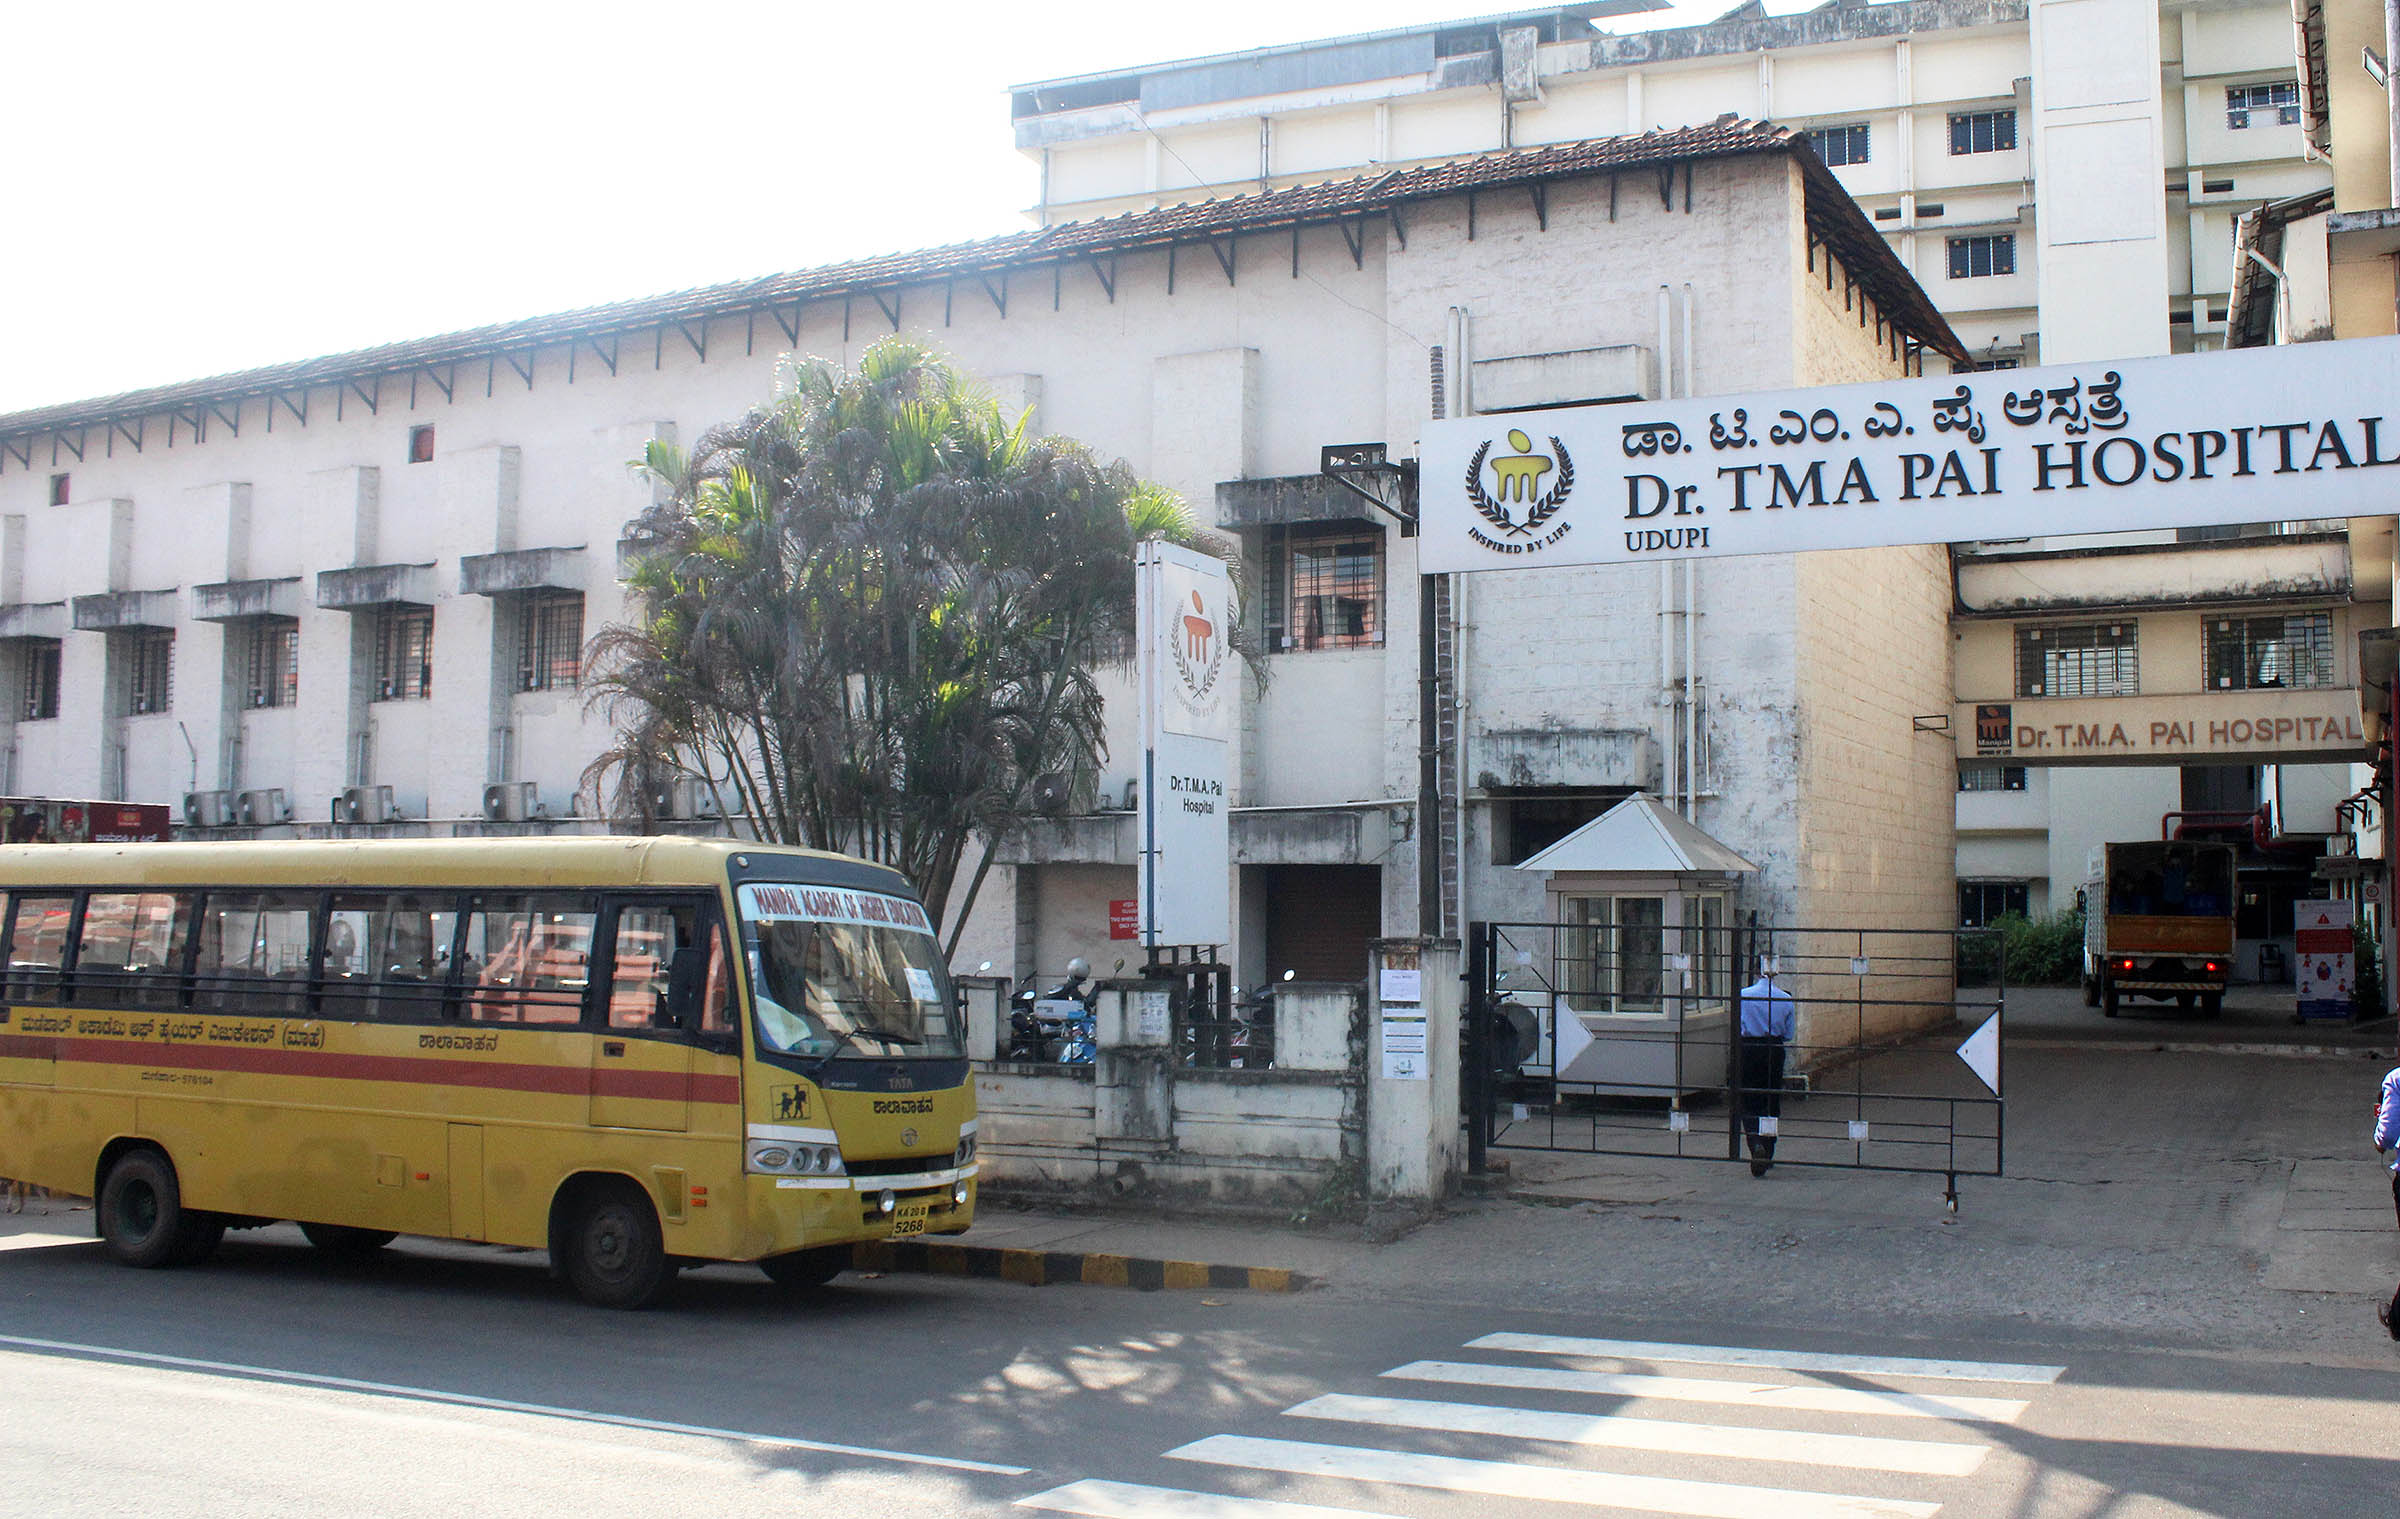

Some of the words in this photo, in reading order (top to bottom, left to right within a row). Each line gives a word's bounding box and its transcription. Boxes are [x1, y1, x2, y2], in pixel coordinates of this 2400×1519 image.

[1622, 421, 1692, 457] ಡಾ.
[1709, 408, 1758, 450] ಟಿ.
[1770, 408, 1850, 445] ಎಂ.
[1864, 401, 1914, 439] ಎ.
[1932, 384, 1986, 444] ಪೈ
[2003, 370, 2129, 435] ಆಸ್ಪತ್ರೆ
[1623, 474, 1705, 519] Dr.
[1717, 456, 1880, 512] TMA
[1898, 447, 2002, 500] PAI
[2032, 416, 2400, 491] HOSPITAL
[1468, 526, 1522, 554] INSPIRED
[1526, 540, 1544, 554] BY
[1546, 521, 1572, 546] LIFE
[1624, 527, 1710, 552] UDUPI
[2150, 720, 2194, 745] PAI
[2210, 716, 2362, 743] HOSPITAL
[1211, 780, 1222, 796] Pai
[1183, 798, 1214, 816] Hospital
[752, 887, 801, 915] MANIPAL
[801, 889, 845, 918] ACADEMY
[844, 894, 859, 919] OF
[886, 898, 927, 929] EDUCATION
[419, 1034, 498, 1051] ಶಾಲಾವಾಹನ
[888, 1078, 913, 1089] TATA
[873, 1096, 933, 1114] ಶಾಲಾವಾಹನ
[895, 1219, 924, 1233] 5268
